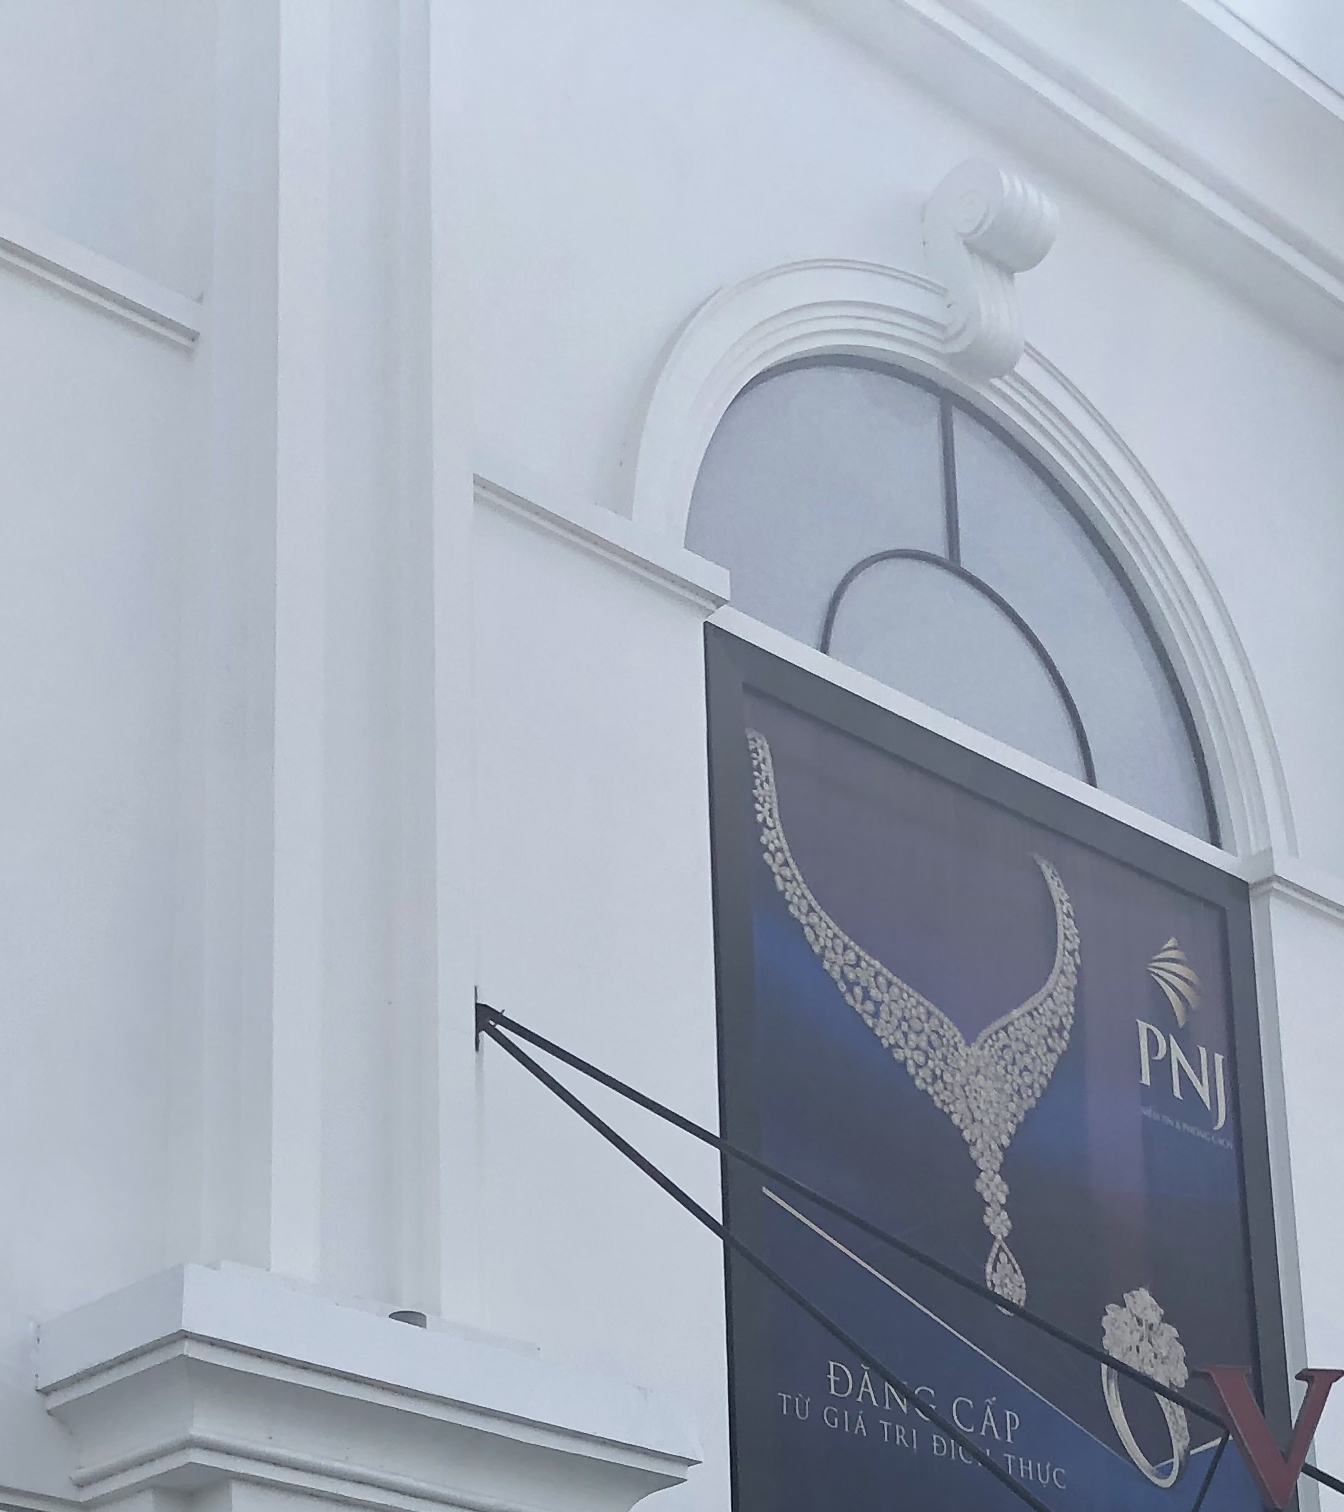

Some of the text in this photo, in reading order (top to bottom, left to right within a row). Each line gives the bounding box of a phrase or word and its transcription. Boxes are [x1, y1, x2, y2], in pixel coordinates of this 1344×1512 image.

[1136, 1018, 1226, 1131] PNJ
[778, 1392, 810, 1420] TỪ
[879, 1420, 918, 1453] TRỊ
[1004, 1453, 1067, 1489] THỰC
[952, 1396, 1020, 1443] CẤP
